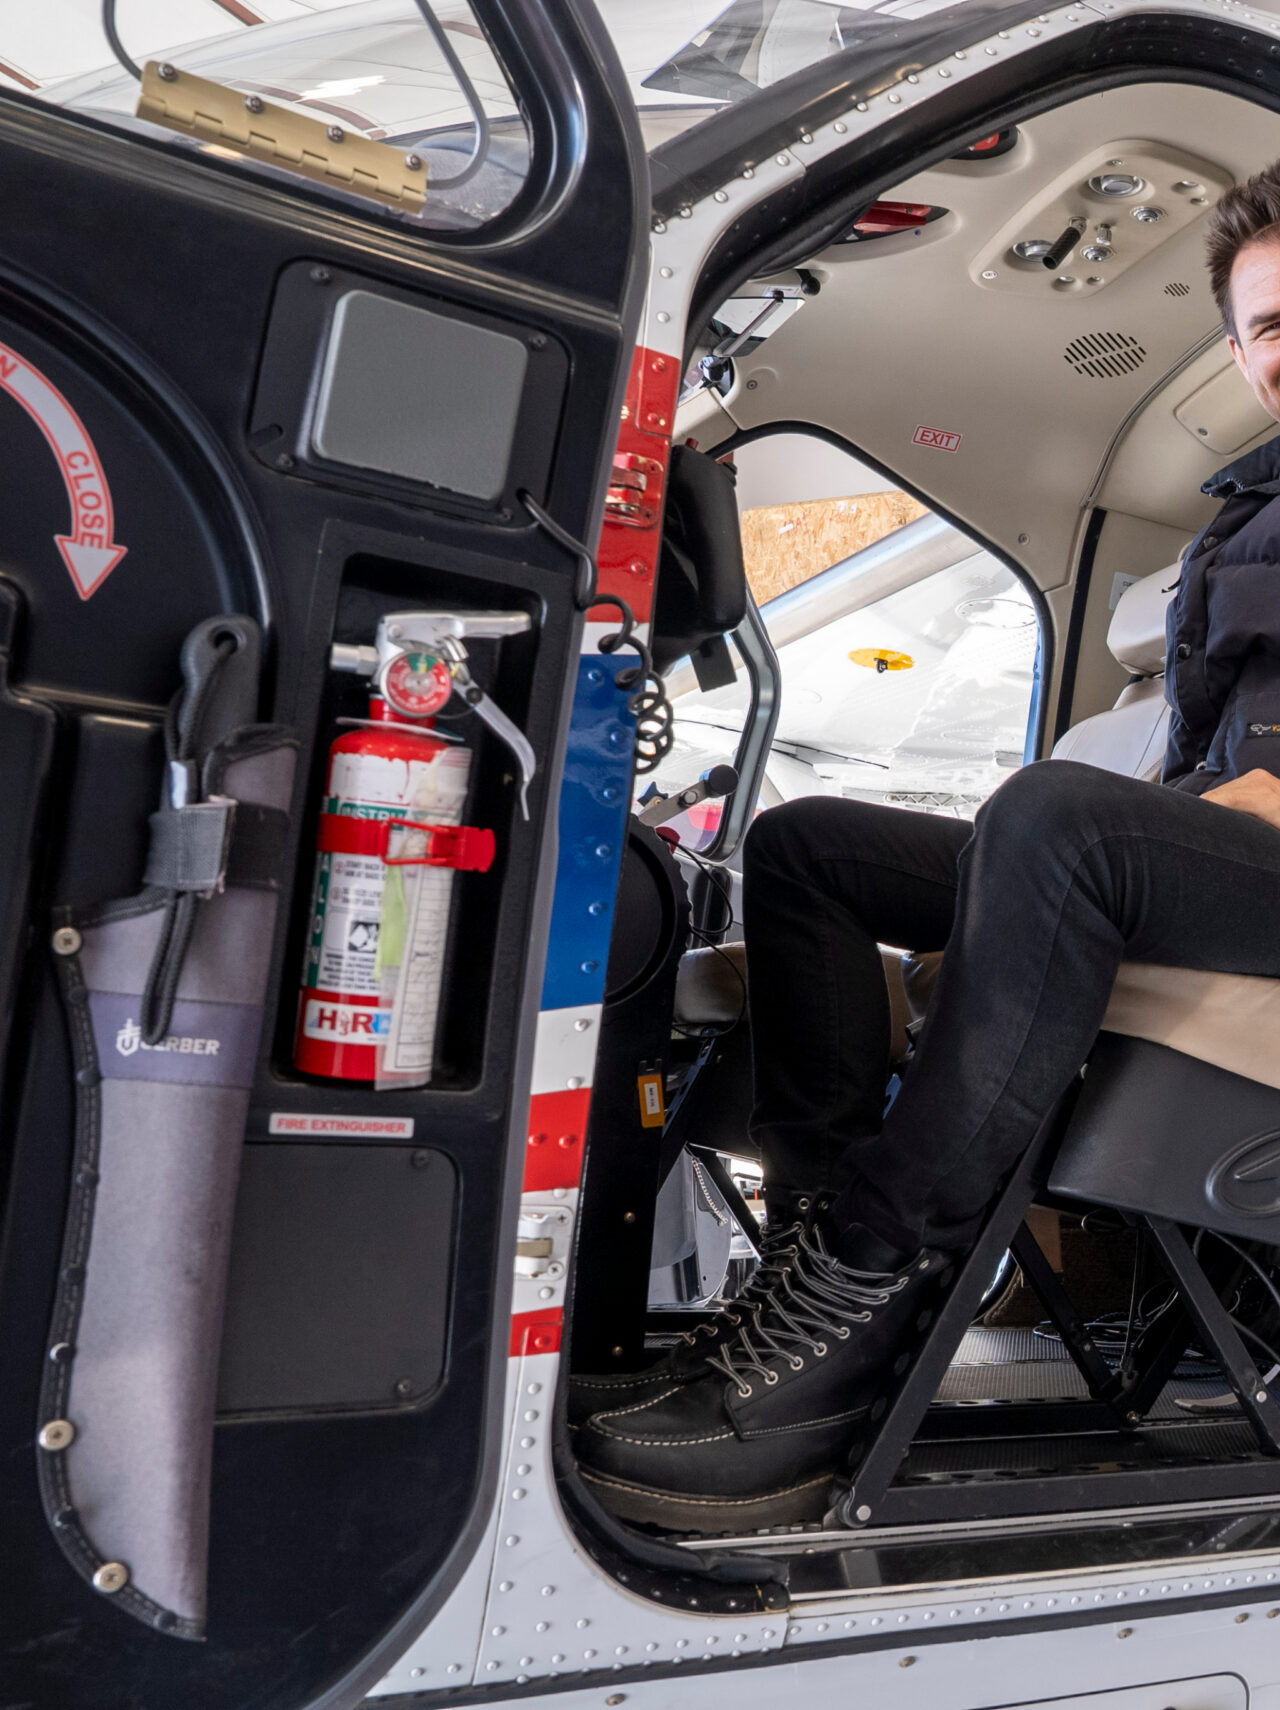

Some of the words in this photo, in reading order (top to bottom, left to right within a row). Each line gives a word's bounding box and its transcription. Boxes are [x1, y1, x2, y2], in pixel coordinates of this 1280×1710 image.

[920, 430, 955, 447] EXIT
[66, 450, 105, 549] CLOSE
[276, 1117, 307, 1130] FIRE
[310, 1119, 406, 1133] EXTINGUISHER
